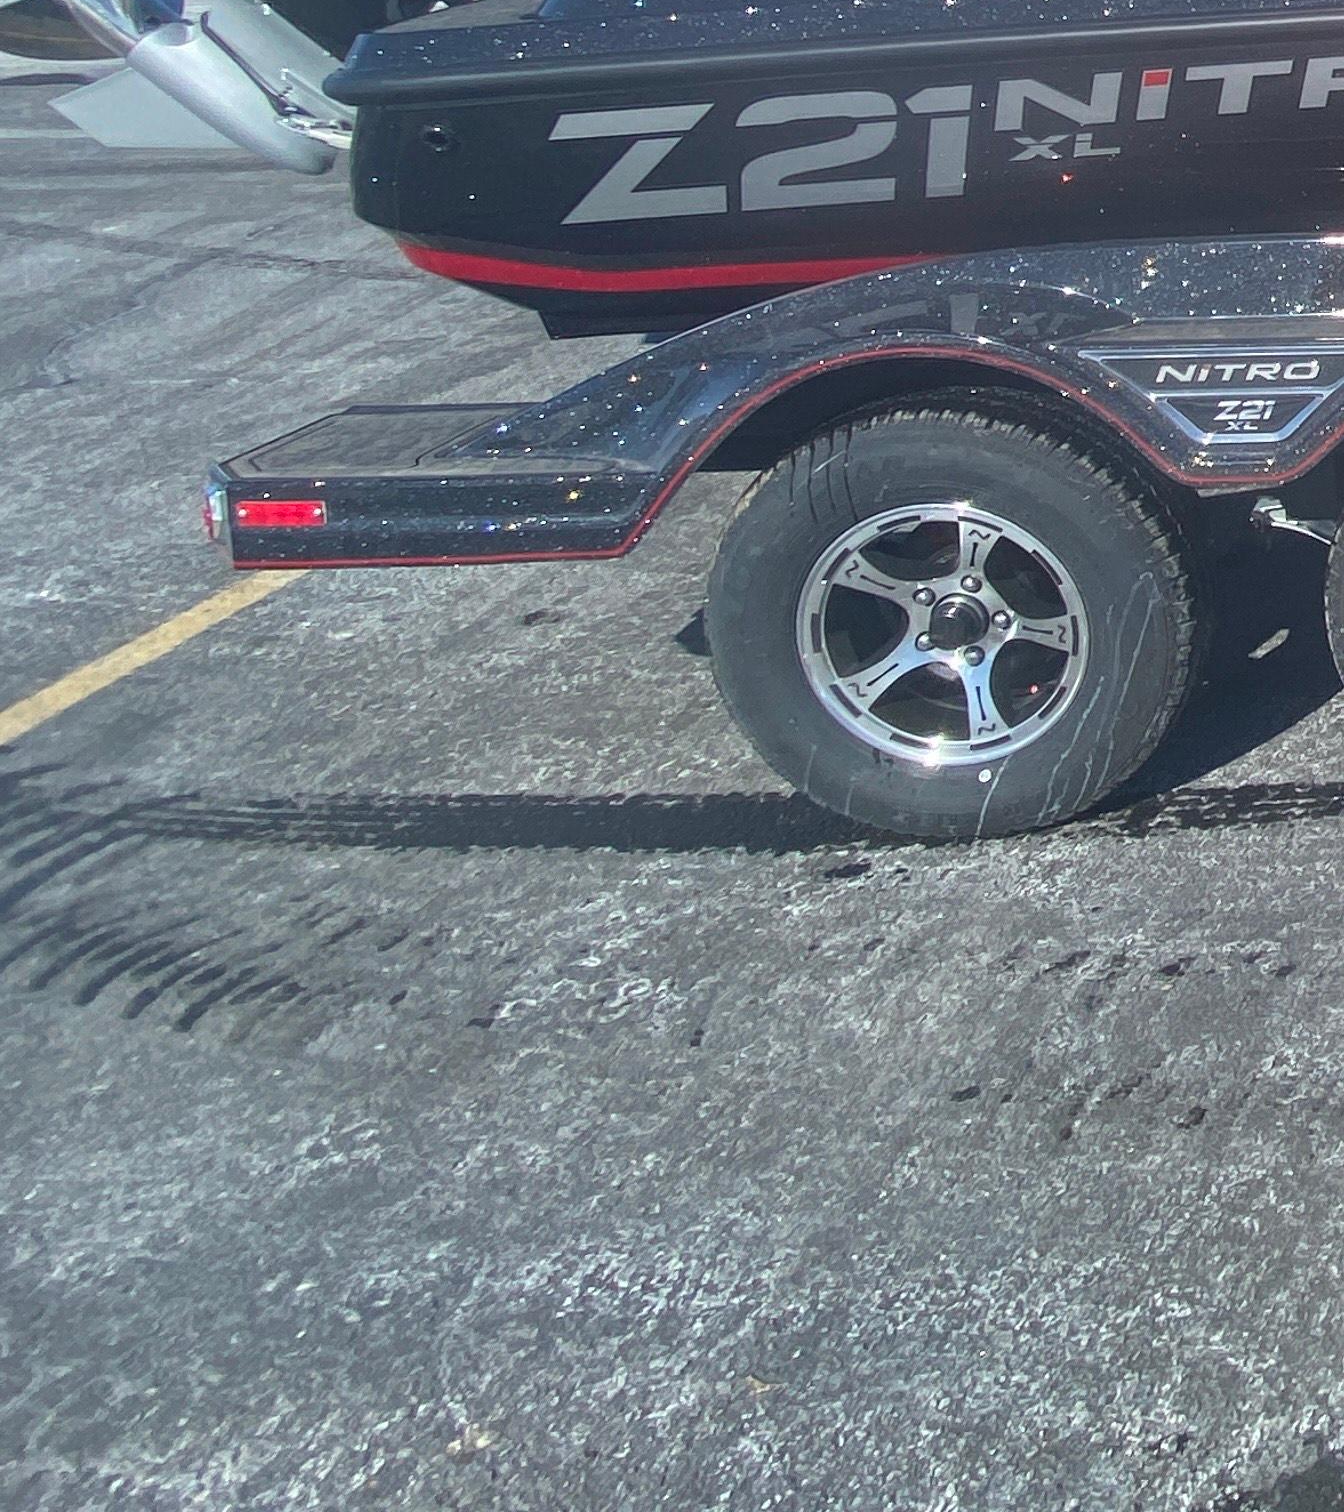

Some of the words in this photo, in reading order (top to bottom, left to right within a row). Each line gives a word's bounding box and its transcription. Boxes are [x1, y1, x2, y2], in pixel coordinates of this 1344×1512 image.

[548, 85, 973, 225] Z21
[1008, 132, 1122, 162] XL
[1213, 399, 1277, 421] Z21
[1225, 420, 1259, 431] XL
